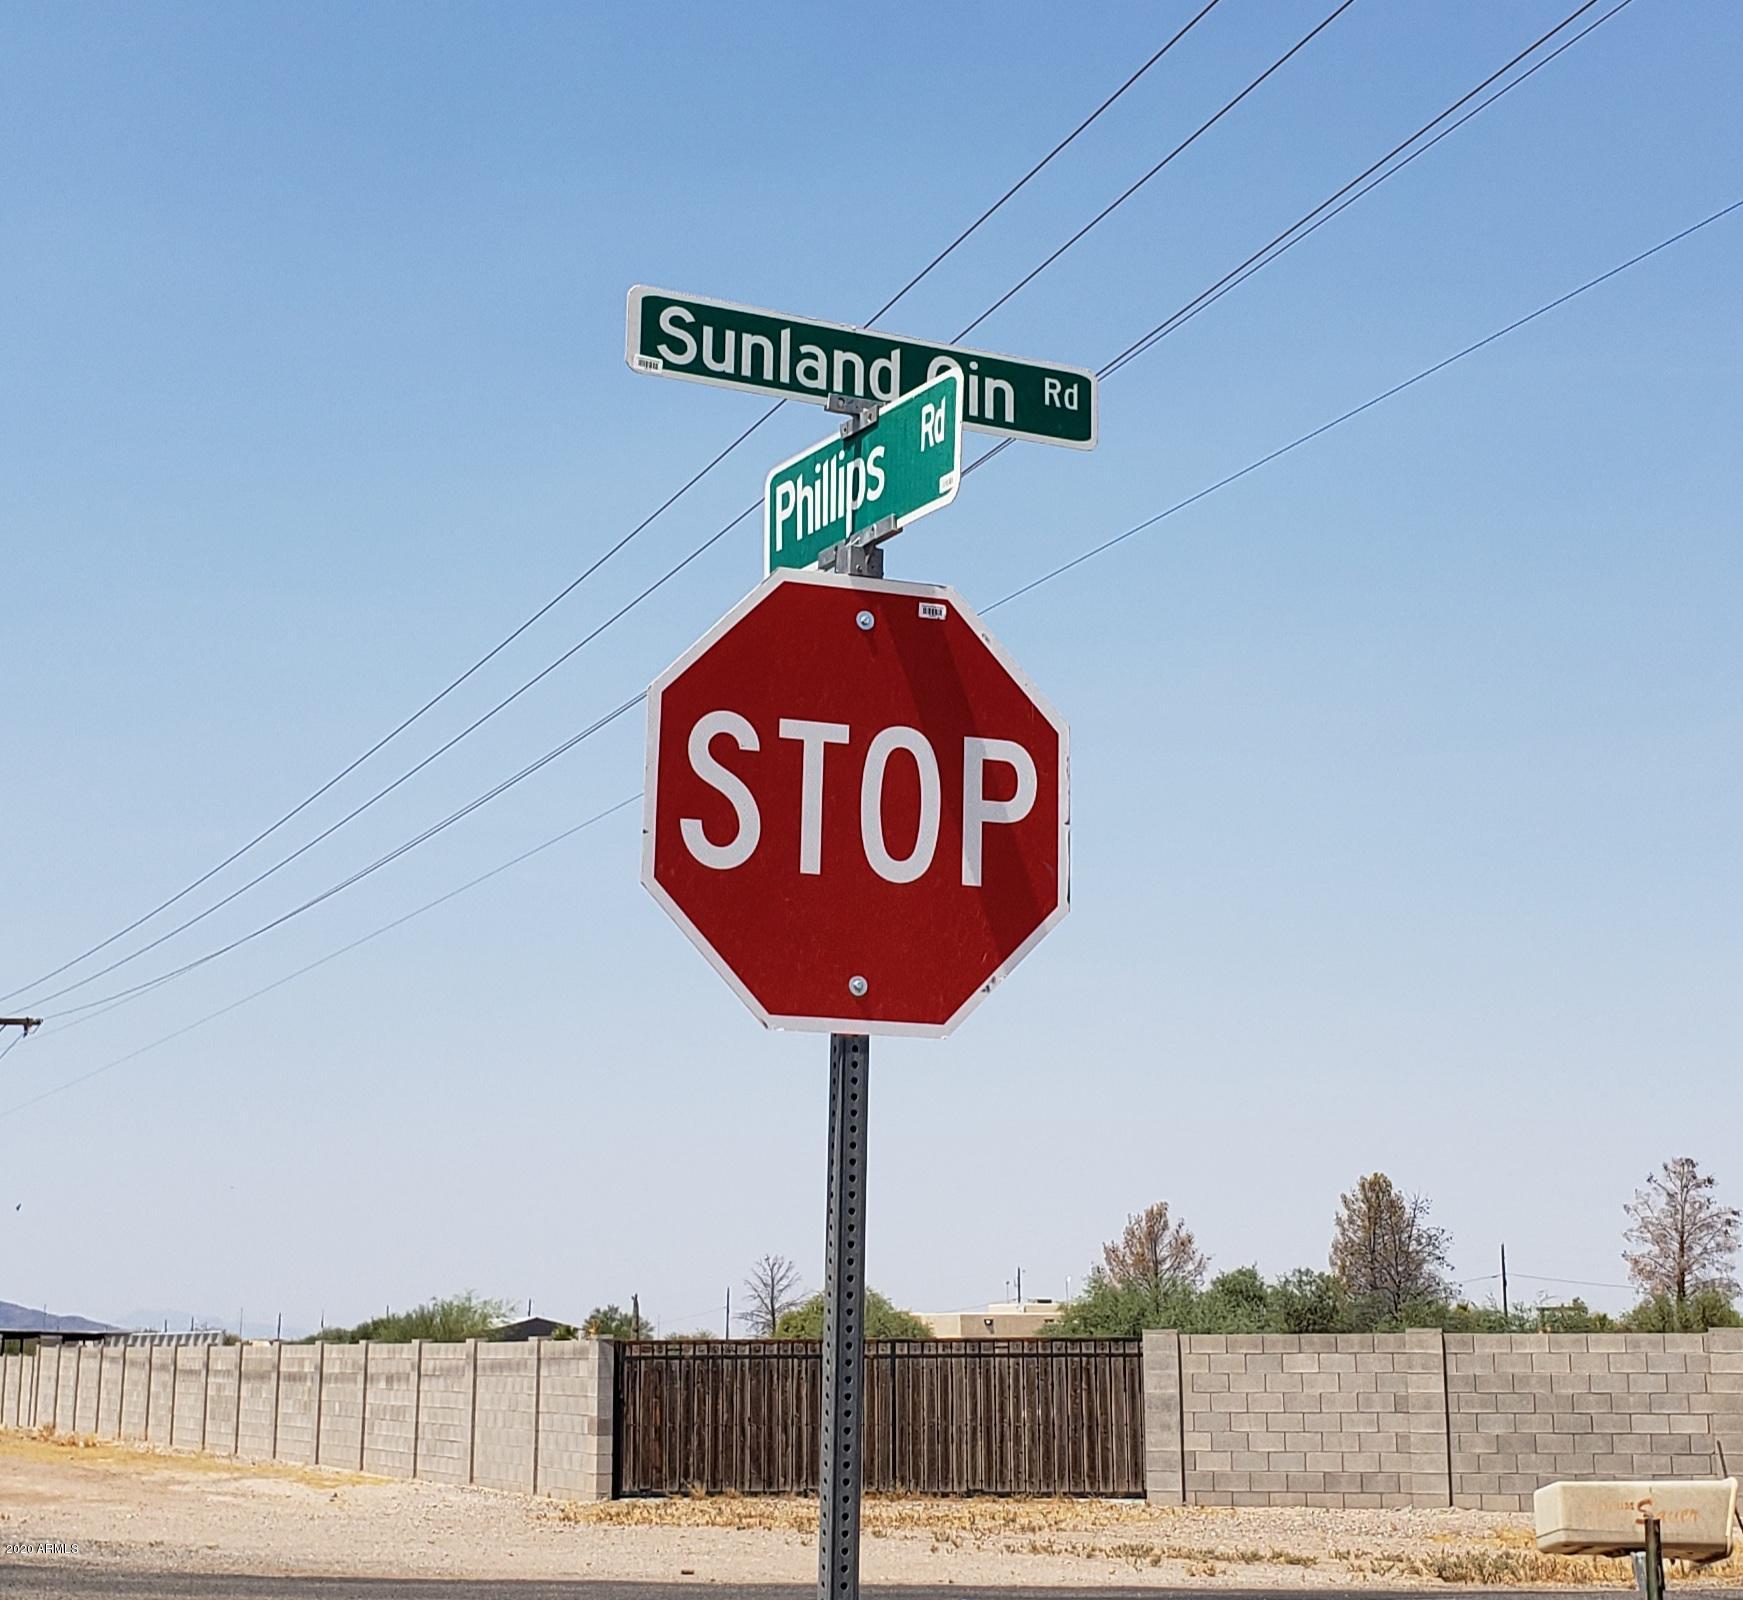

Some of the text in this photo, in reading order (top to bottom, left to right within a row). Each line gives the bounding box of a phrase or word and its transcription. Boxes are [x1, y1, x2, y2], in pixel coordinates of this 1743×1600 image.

[657, 306, 899, 402] Sunland
[1043, 376, 1078, 411] Rd
[775, 398, 947, 551] Phillips Rd
[679, 710, 1038, 887] STOP
